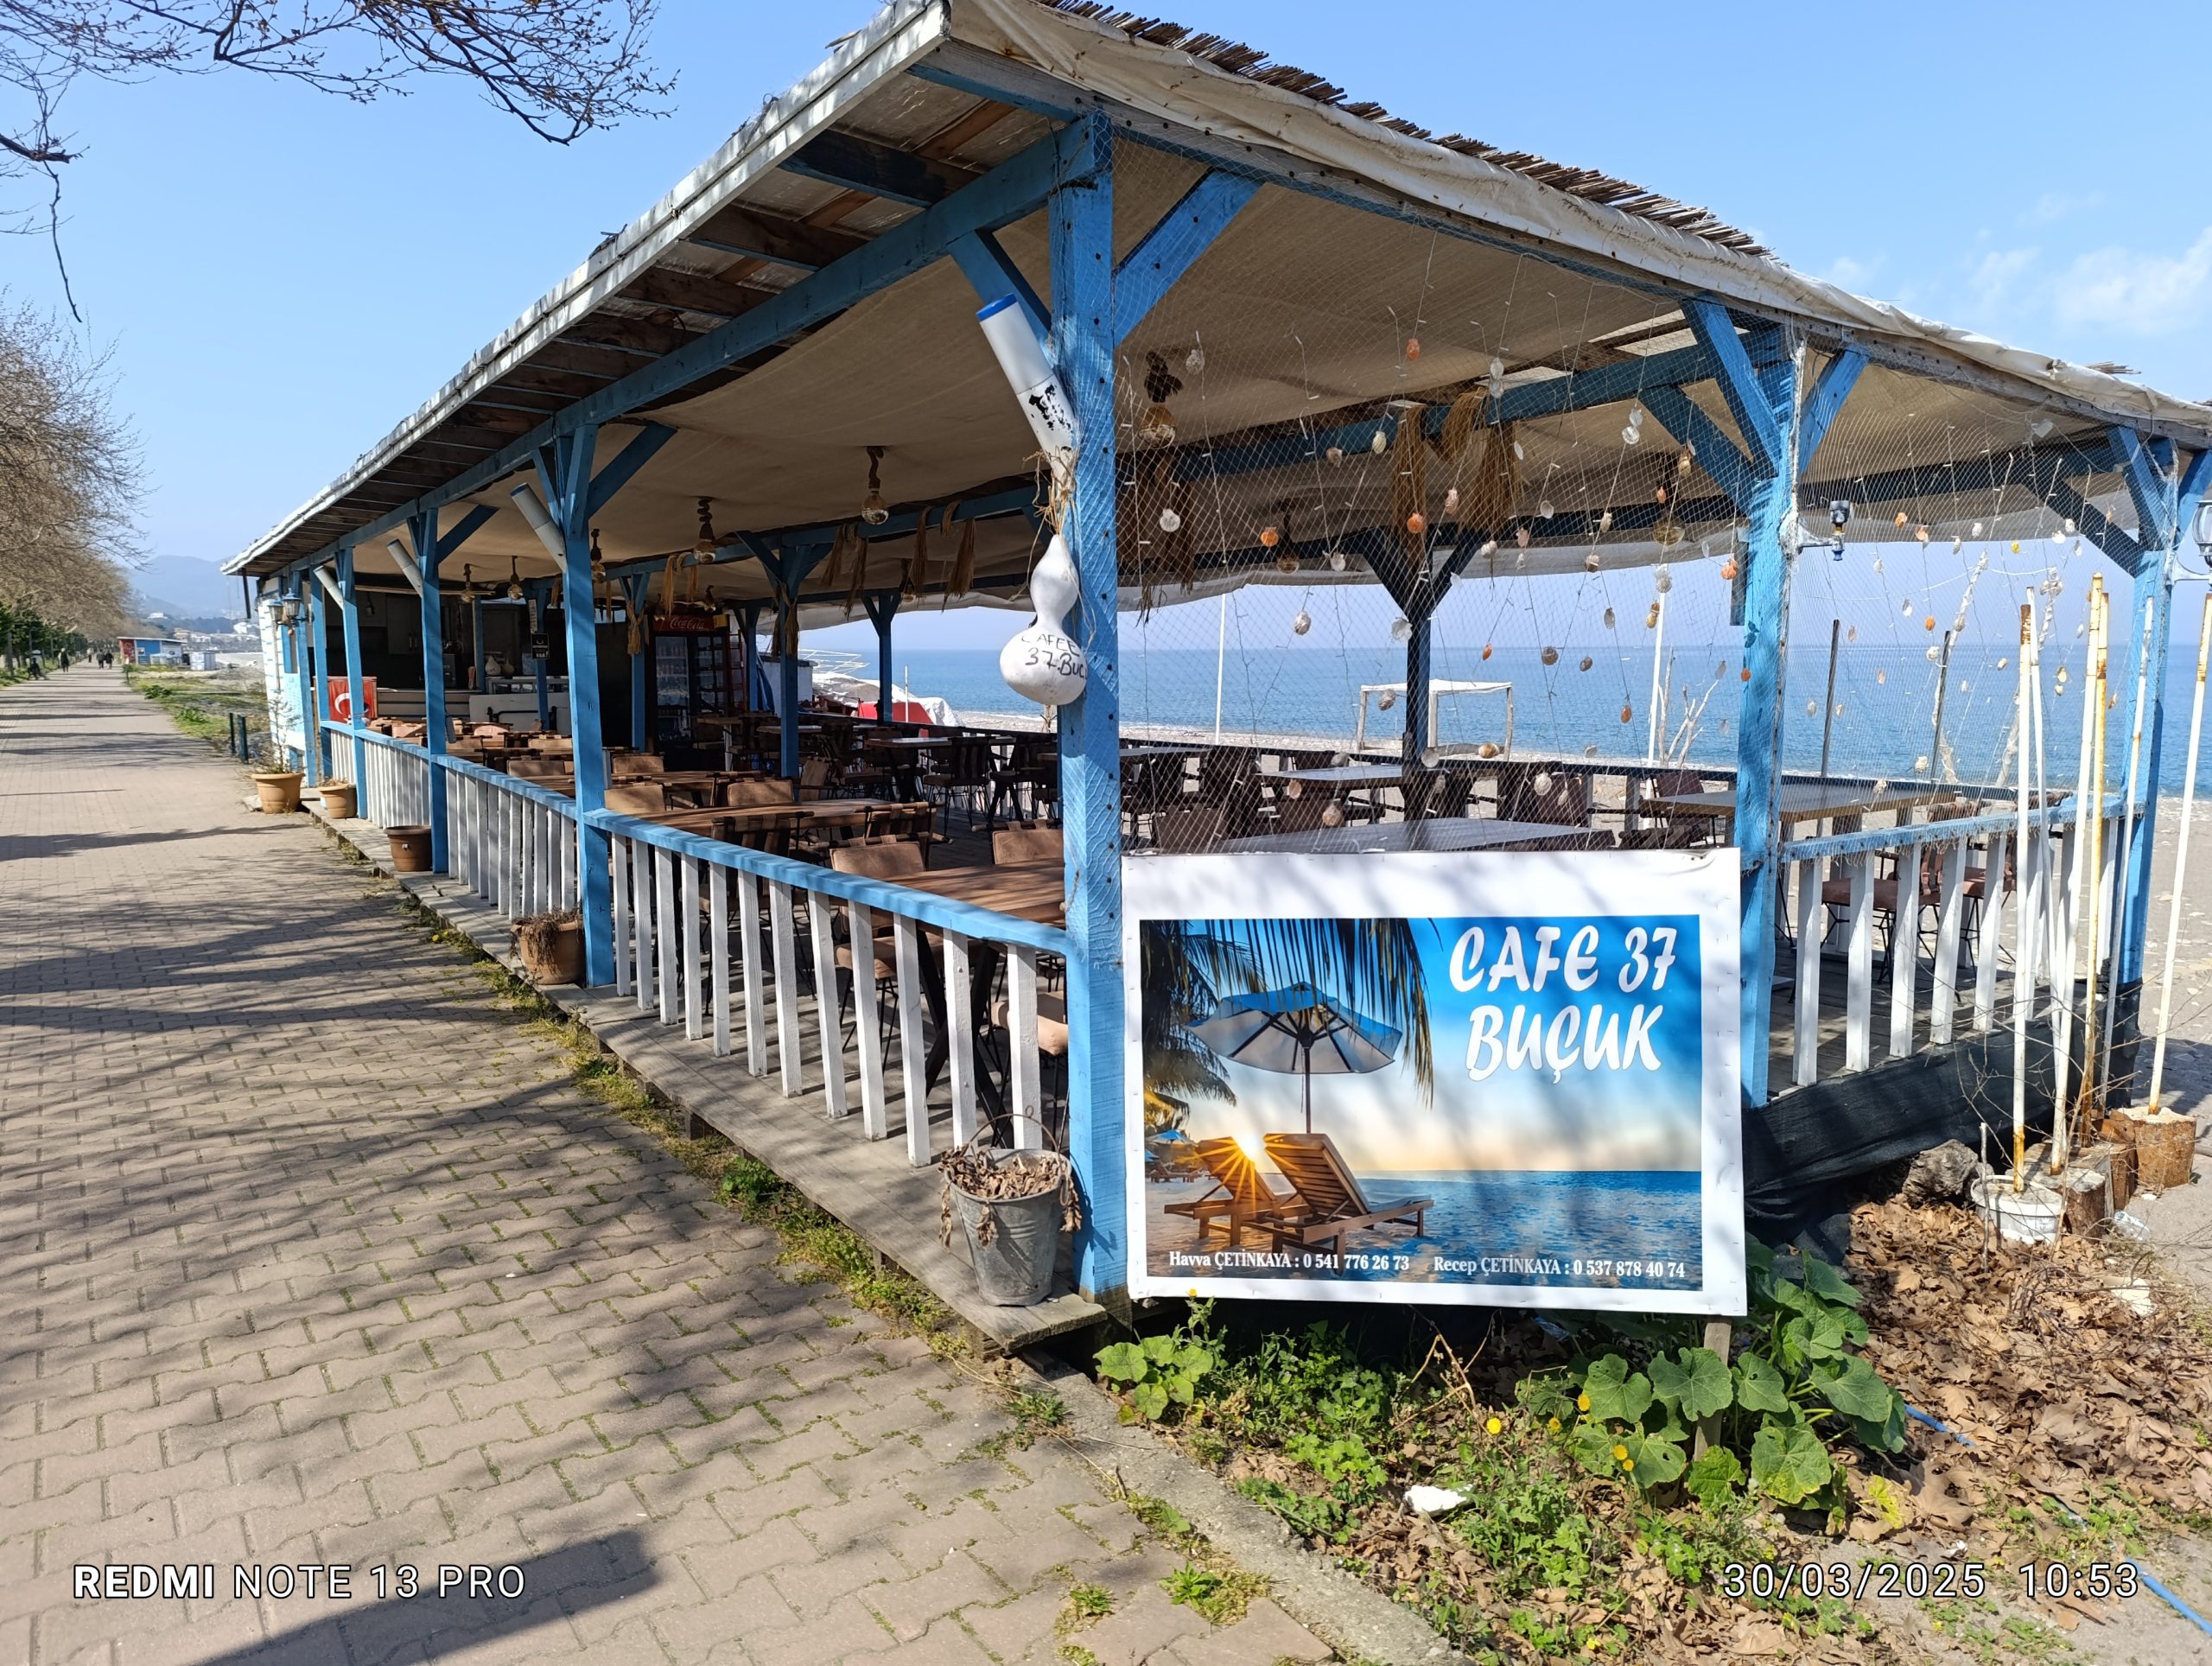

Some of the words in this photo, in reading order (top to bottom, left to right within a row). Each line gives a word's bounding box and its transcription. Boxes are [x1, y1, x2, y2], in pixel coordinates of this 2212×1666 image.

[1449, 925, 1599, 992] CAFE
[1618, 927, 1677, 993] 37
[1465, 1004, 1663, 1084] BUÇUK
[1169, 1251, 1211, 1267] Havva
[1214, 1249, 1292, 1270] ÇETİNKAYA
[1303, 1254, 1311, 1269] 0
[1315, 1254, 1339, 1269] 541
[1344, 1255, 1369, 1269] 776
[1371, 1255, 1389, 1270] 26
[1393, 1256, 1409, 1270] 73
[1434, 1256, 1478, 1275] Recep
[1481, 1255, 1561, 1276] ÇETİNKAYA
[1573, 1260, 1582, 1275] 0
[1586, 1260, 1611, 1275] 537
[1616, 1261, 1642, 1276] 878
[1646, 1262, 1663, 1277] 40
[1668, 1262, 1685, 1278] 74
